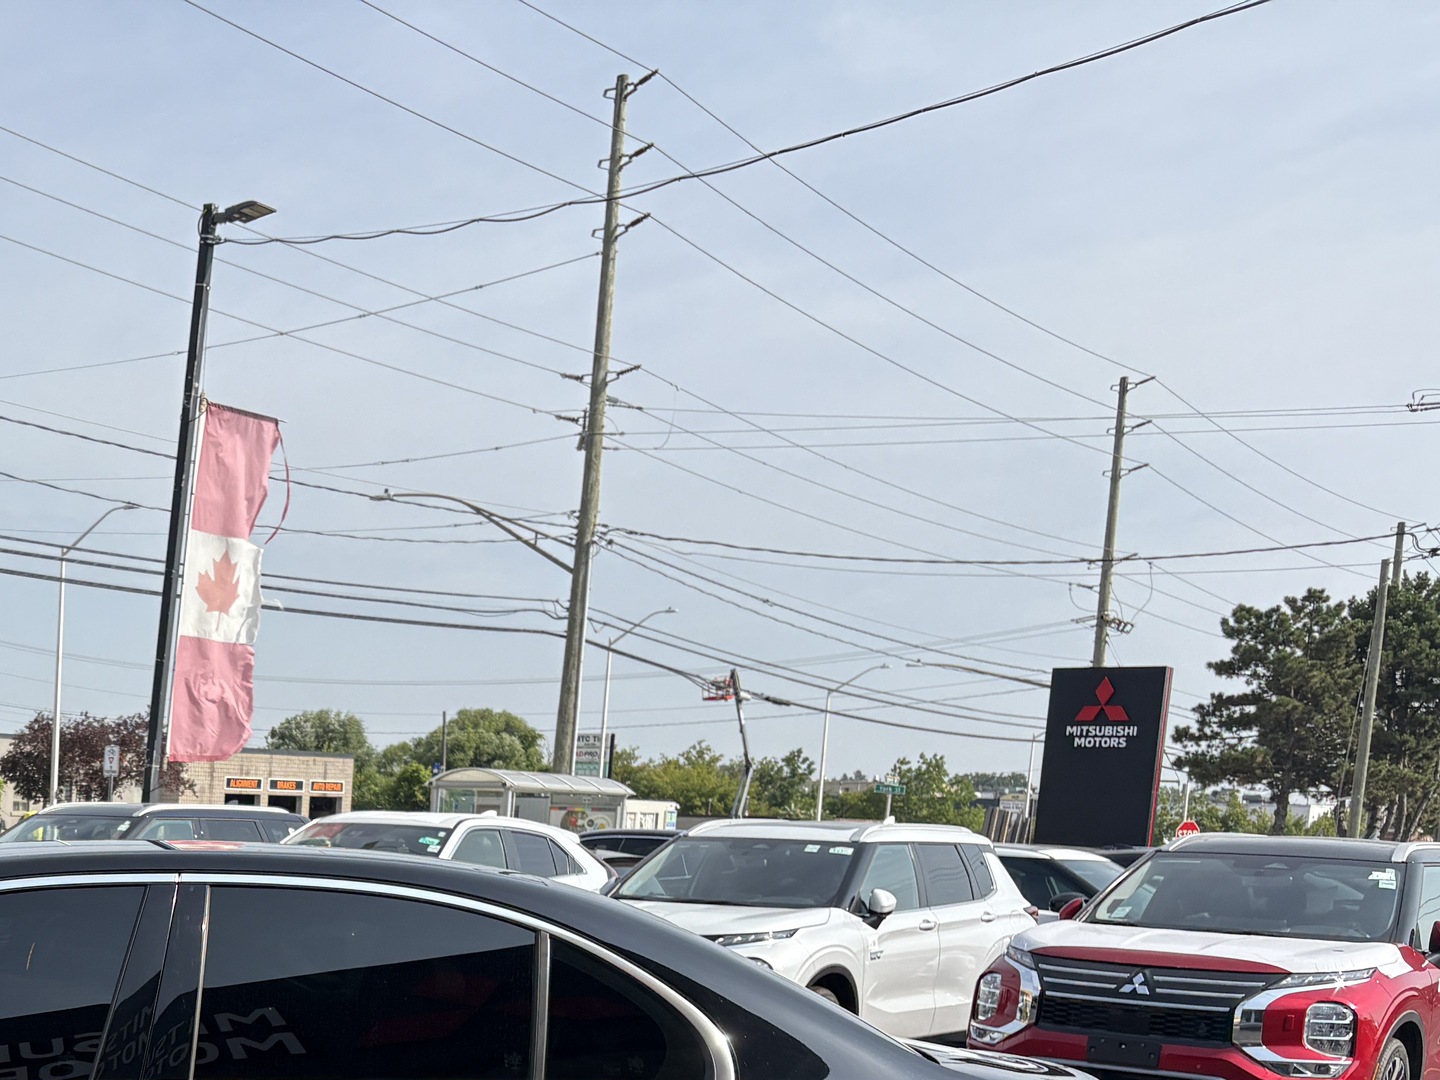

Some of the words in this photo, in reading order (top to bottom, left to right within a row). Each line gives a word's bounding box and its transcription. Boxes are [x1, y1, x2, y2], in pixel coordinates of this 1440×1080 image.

[1065, 725, 1138, 737] MITSUBISHI
[1073, 736, 1127, 748] MOTORS
[229, 778, 258, 789] ALIGNMENT
[276, 780, 296, 790] BRAKES
[312, 782, 325, 791] AUTO
[325, 782, 342, 792] REPAIR
